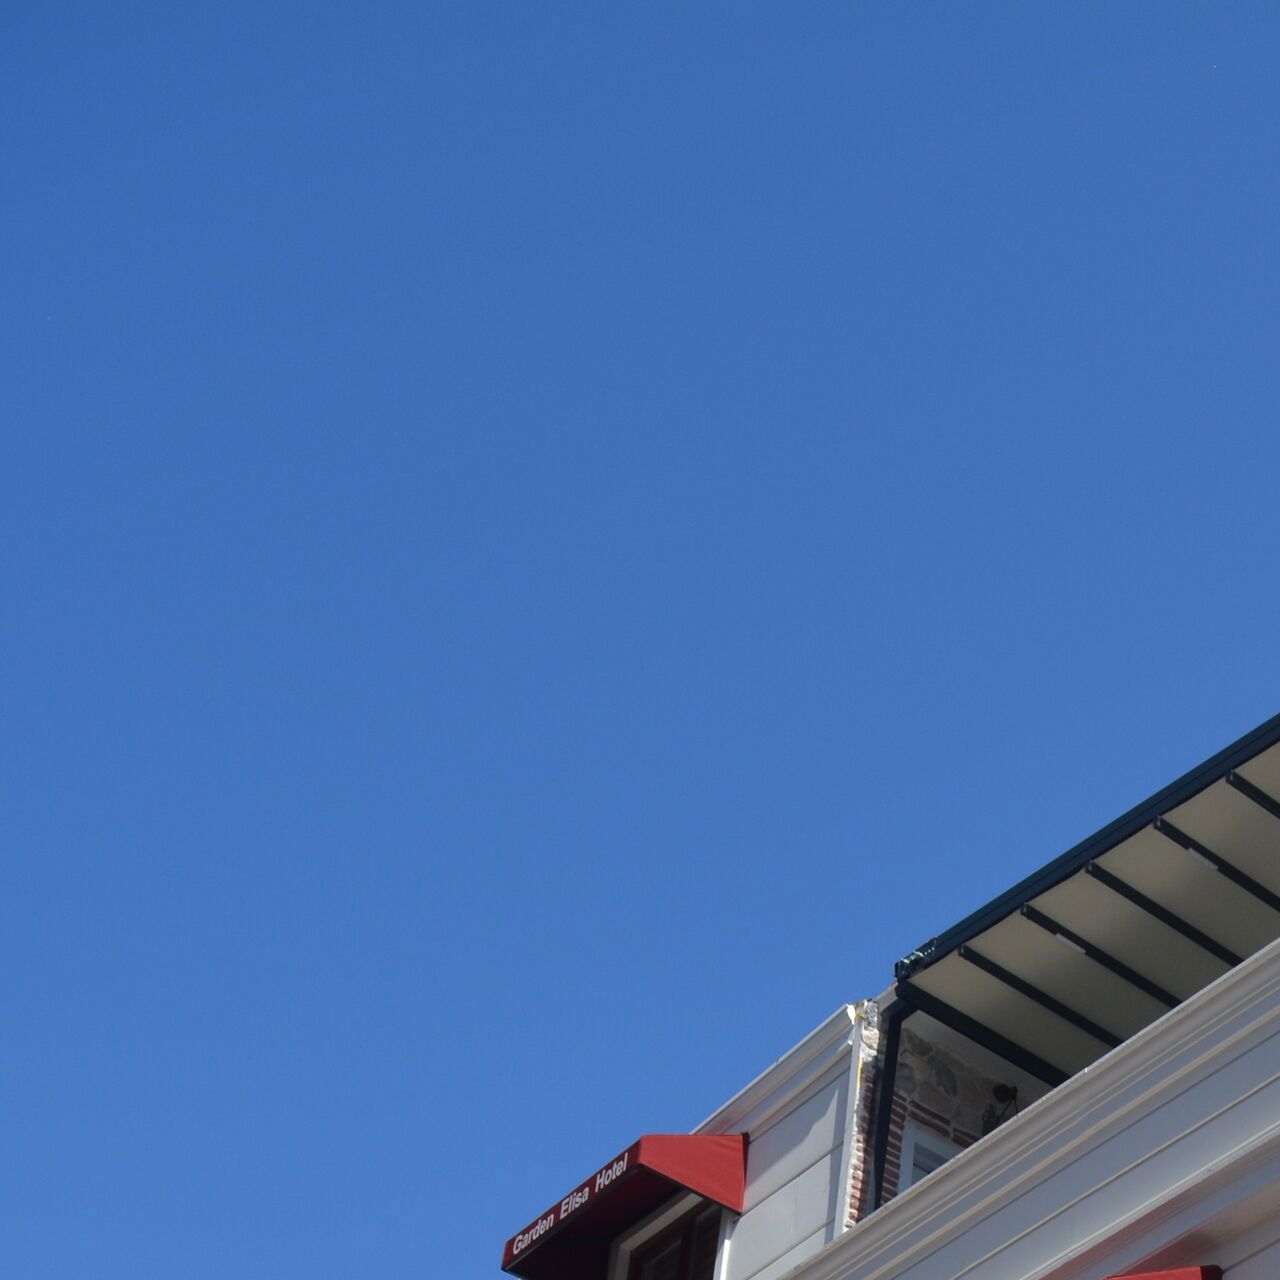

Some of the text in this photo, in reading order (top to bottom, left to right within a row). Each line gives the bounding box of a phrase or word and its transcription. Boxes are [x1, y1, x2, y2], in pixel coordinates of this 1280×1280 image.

[512, 1153, 628, 1255] Garden Elisa Hotel
